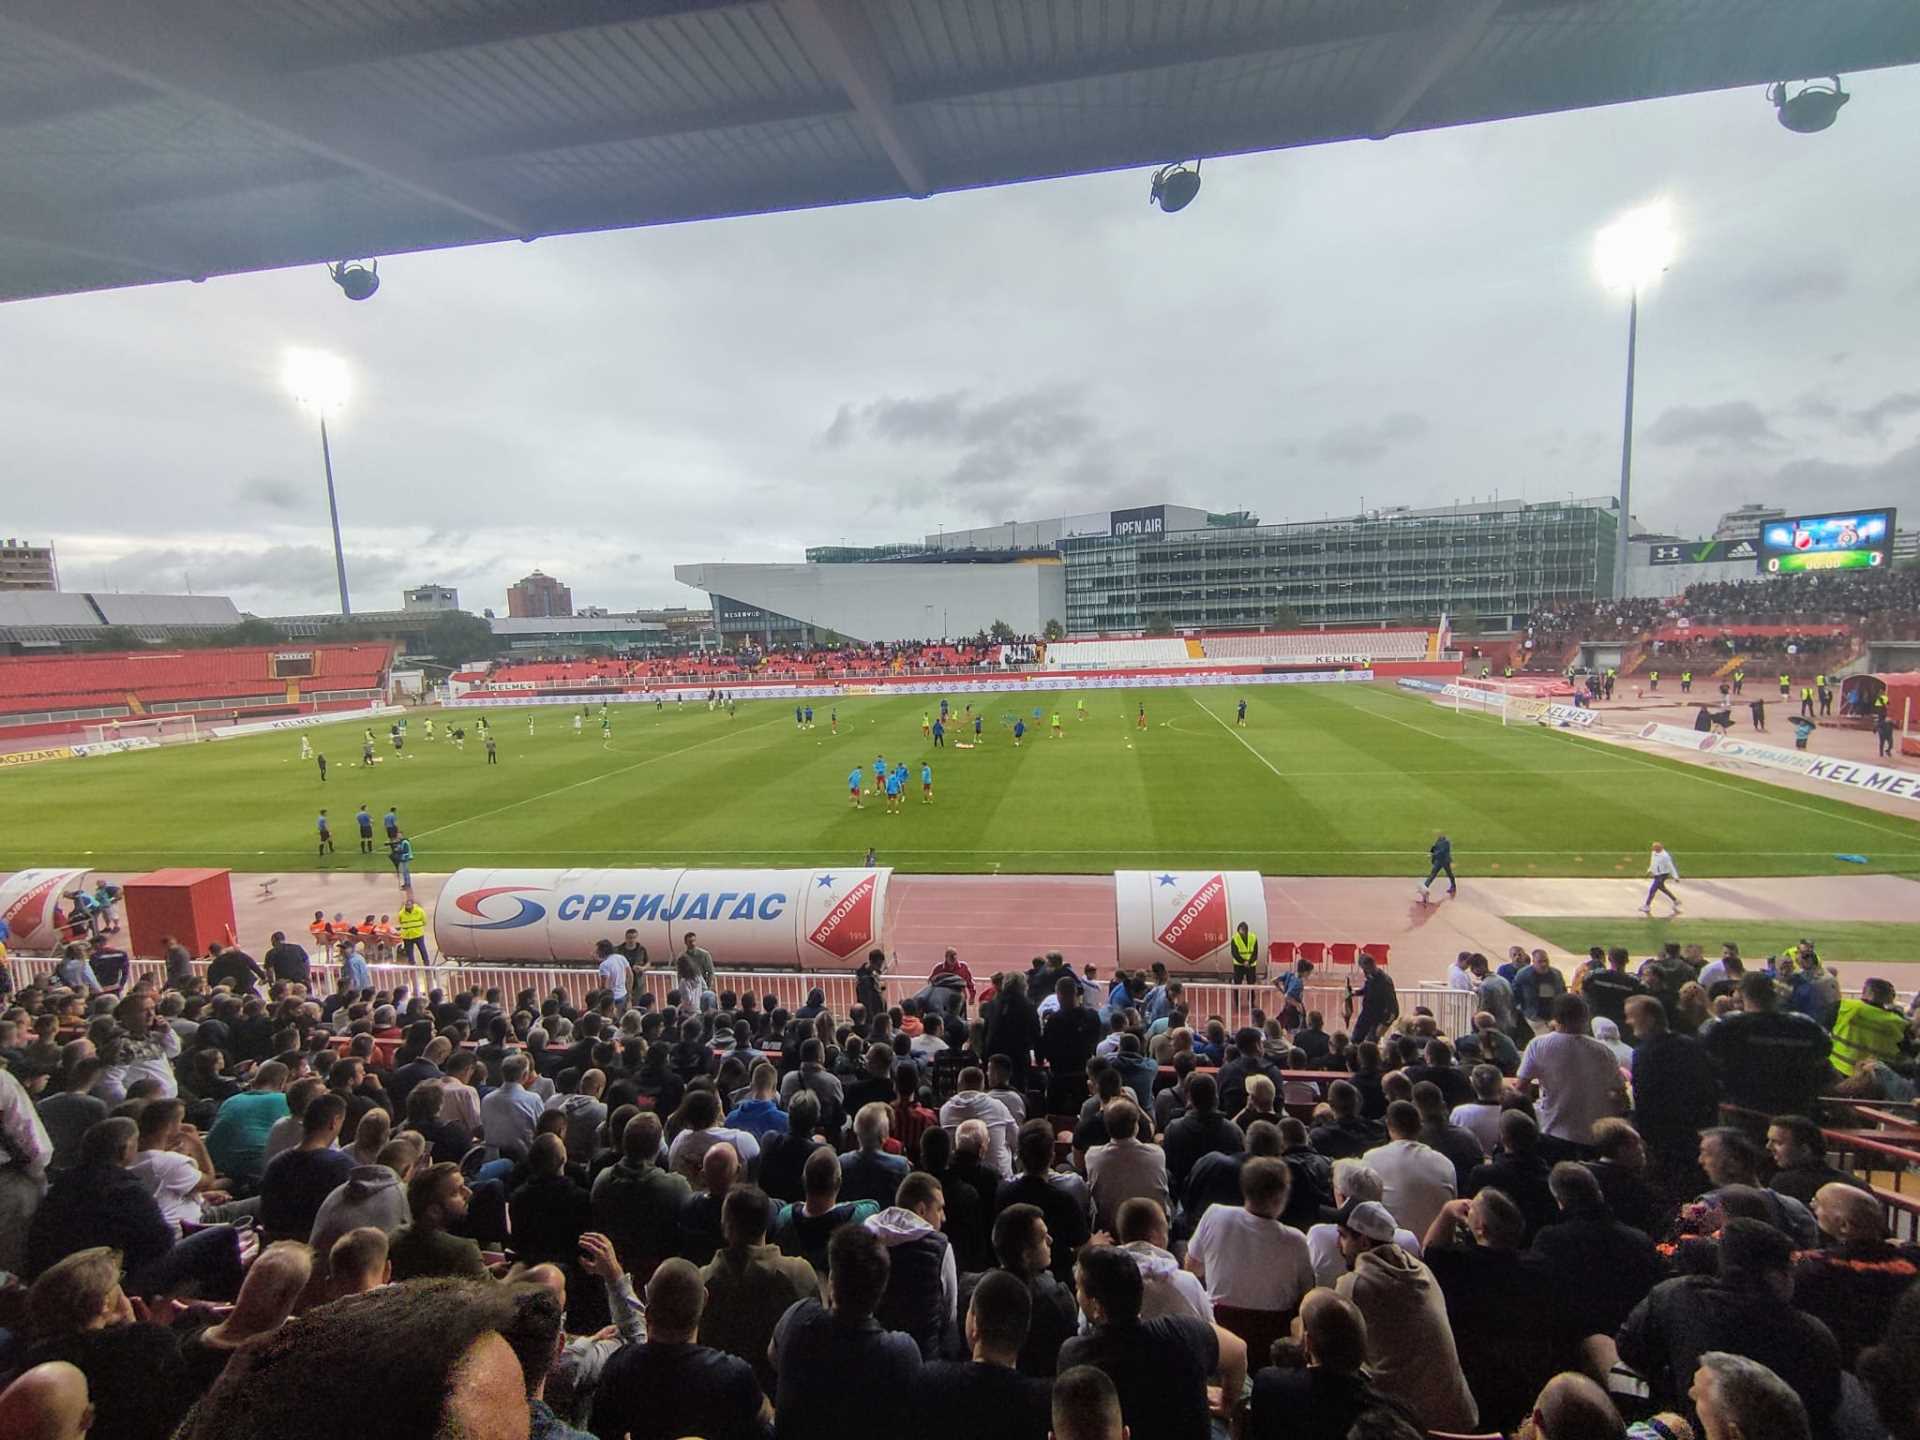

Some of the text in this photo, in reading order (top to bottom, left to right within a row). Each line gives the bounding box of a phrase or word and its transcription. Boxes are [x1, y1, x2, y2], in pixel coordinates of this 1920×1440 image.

[1115, 517, 1162, 536] OPEN AIR
[1768, 558, 1780, 572] 0
[1315, 655, 1360, 664] KELME
[272, 717, 317, 729] KELME
[1808, 759, 1912, 795] KELME
[557, 893, 787, 921] СРБИЈАГАС
[816, 882, 873, 943] ВОЈВОДИНА
[1164, 882, 1222, 944] ВОЈВОДИНА
